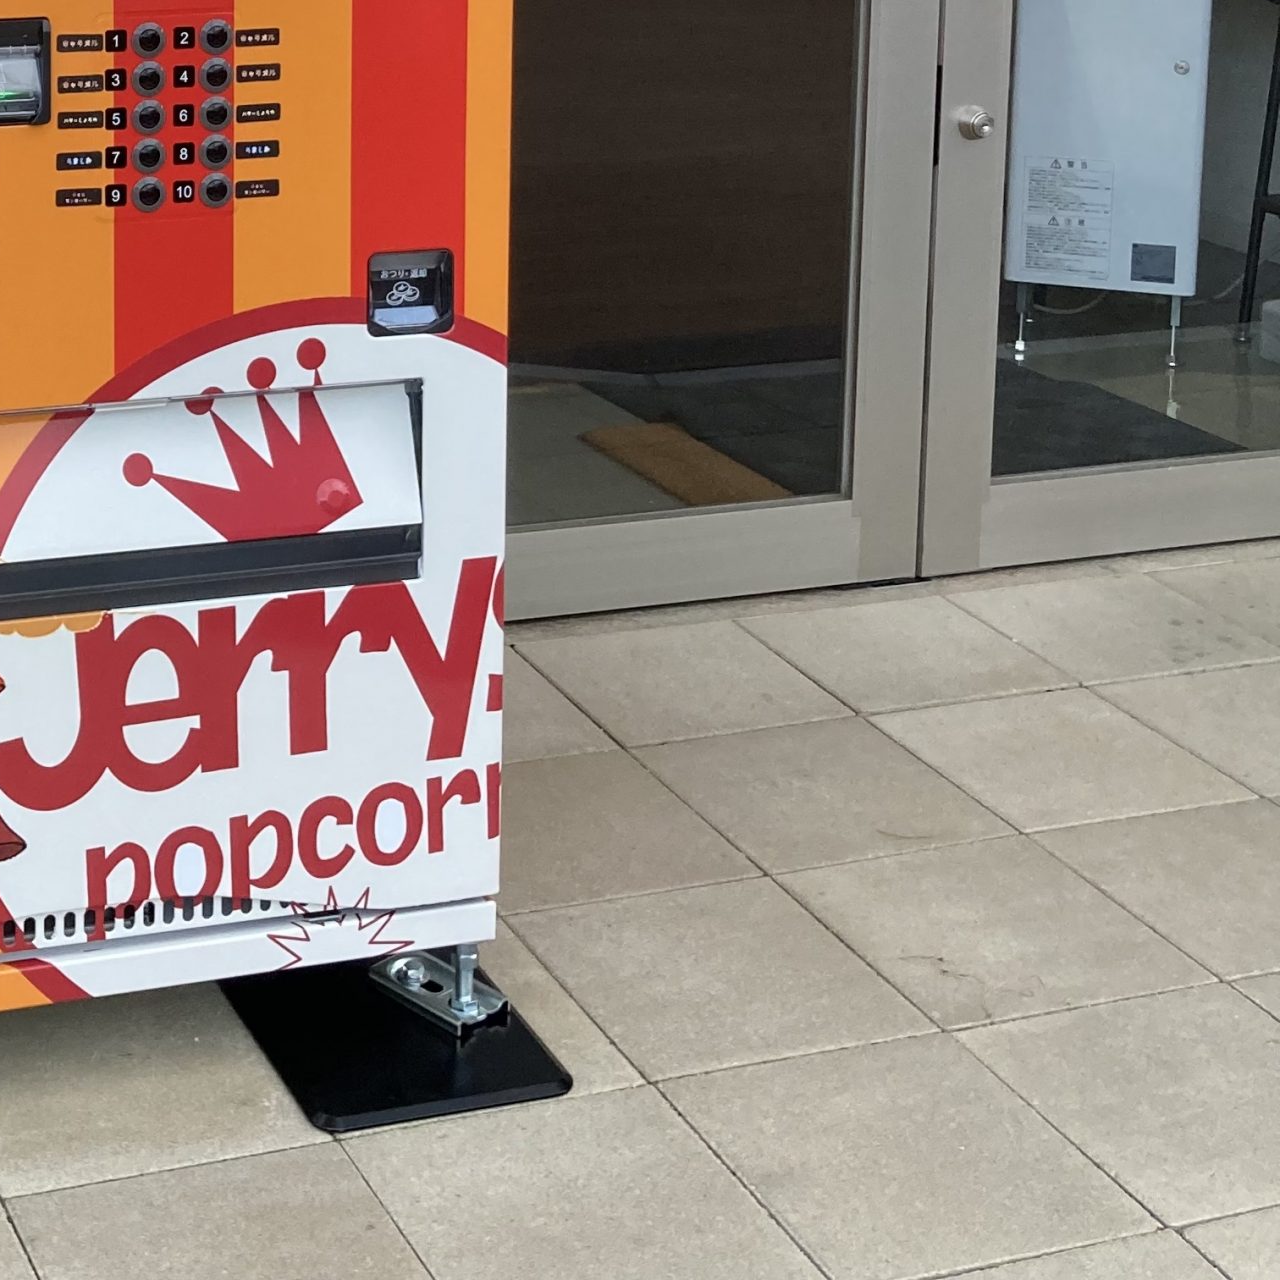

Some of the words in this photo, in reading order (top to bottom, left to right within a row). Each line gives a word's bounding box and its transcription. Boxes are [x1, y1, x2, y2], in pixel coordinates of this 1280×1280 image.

[113, 35, 118, 47] 1
[180, 32, 189, 44] 2
[111, 74, 120, 86] 3
[180, 70, 188, 83] 4
[112, 113, 120, 125] 5
[179, 109, 188, 121] 6
[112, 151, 120, 164] 7
[180, 147, 188, 160] 8
[112, 190, 120, 202] 9
[177, 185, 192, 198] 10
[381, 268, 427, 279] おつり・返却
